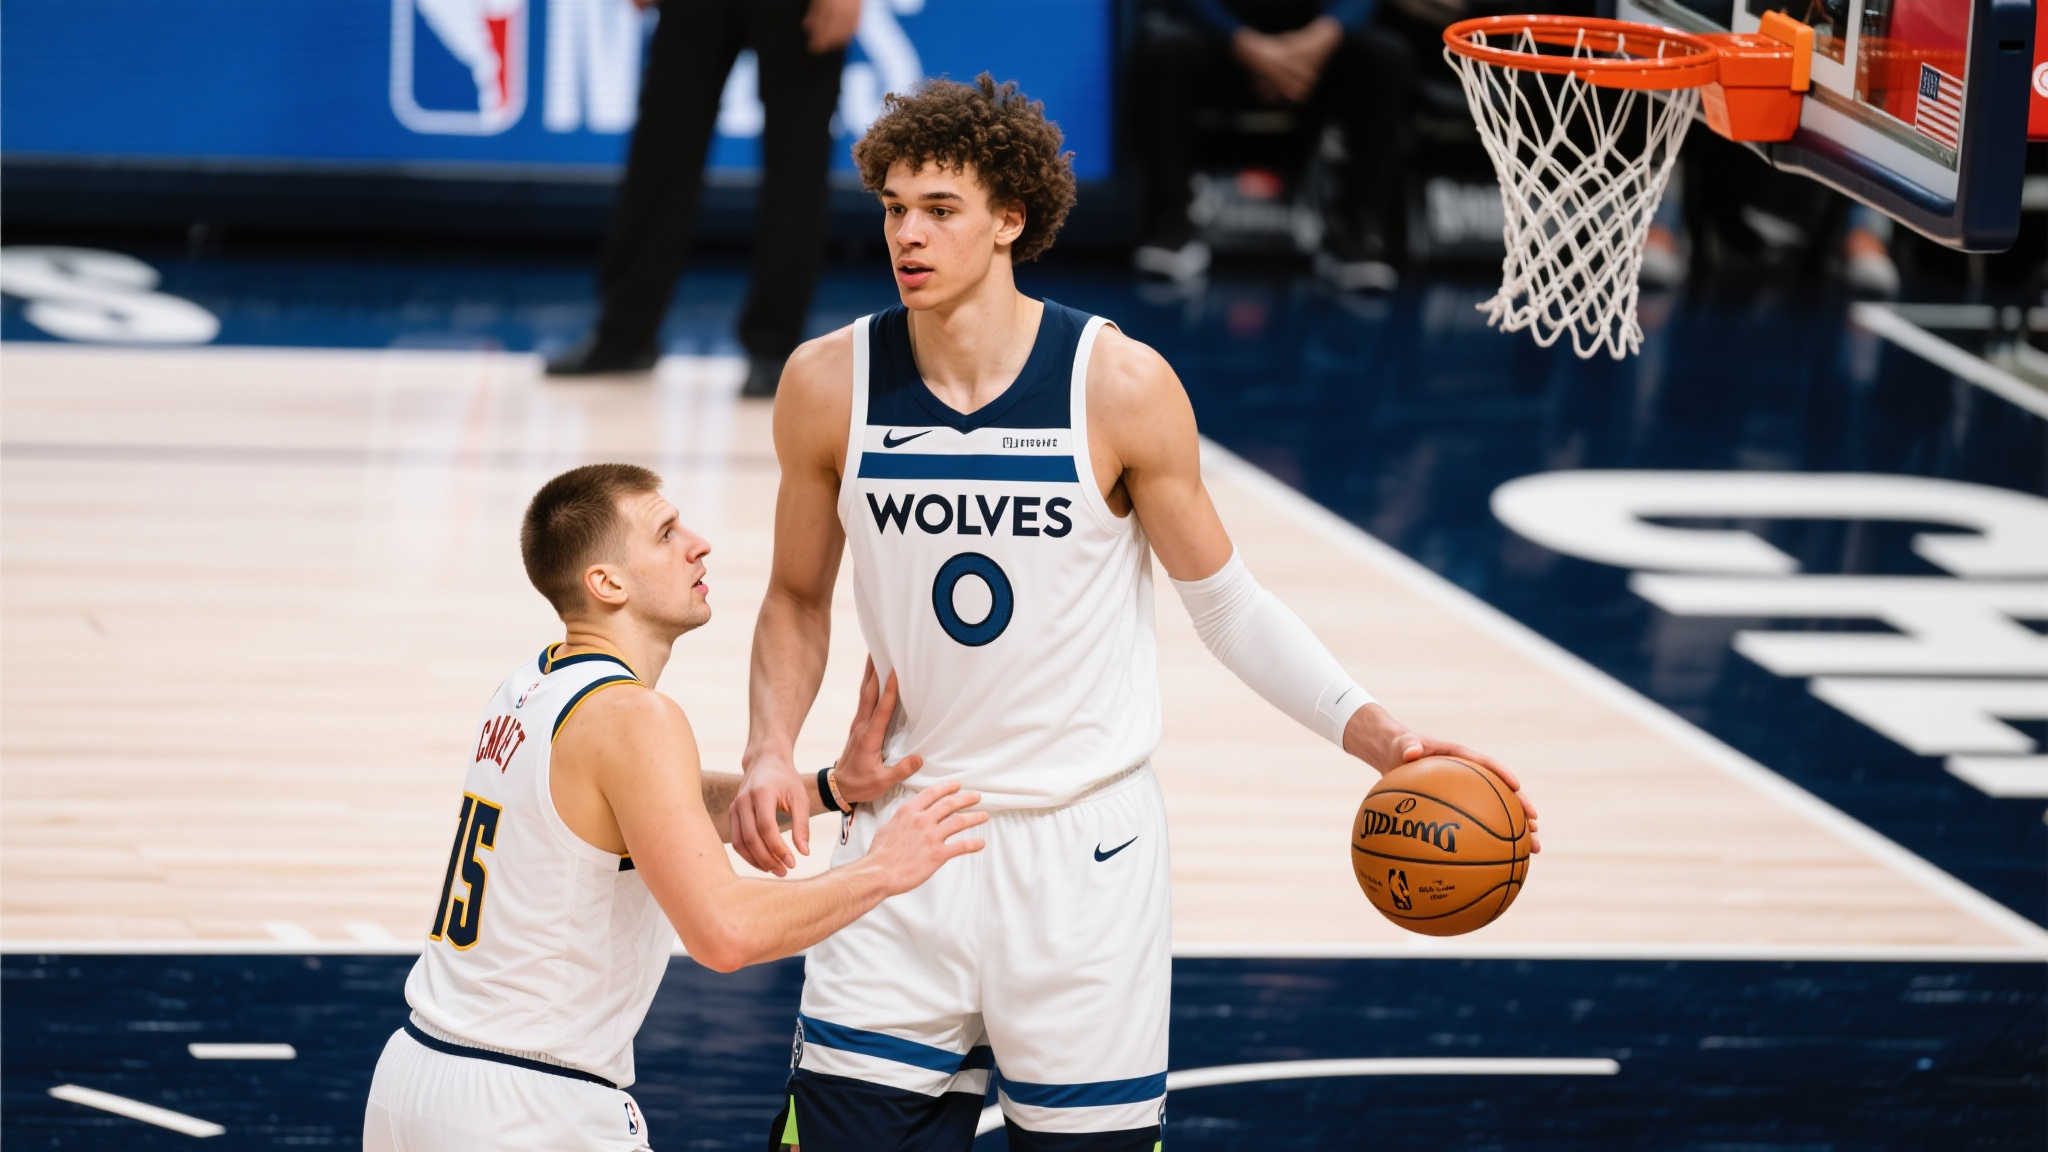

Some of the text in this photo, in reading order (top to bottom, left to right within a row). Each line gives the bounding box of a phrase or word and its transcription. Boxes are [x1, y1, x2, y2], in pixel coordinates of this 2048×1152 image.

[866, 493, 1073, 538] WOLVES
[932, 552, 1014, 647] 0
[429, 792, 502, 951] 15
